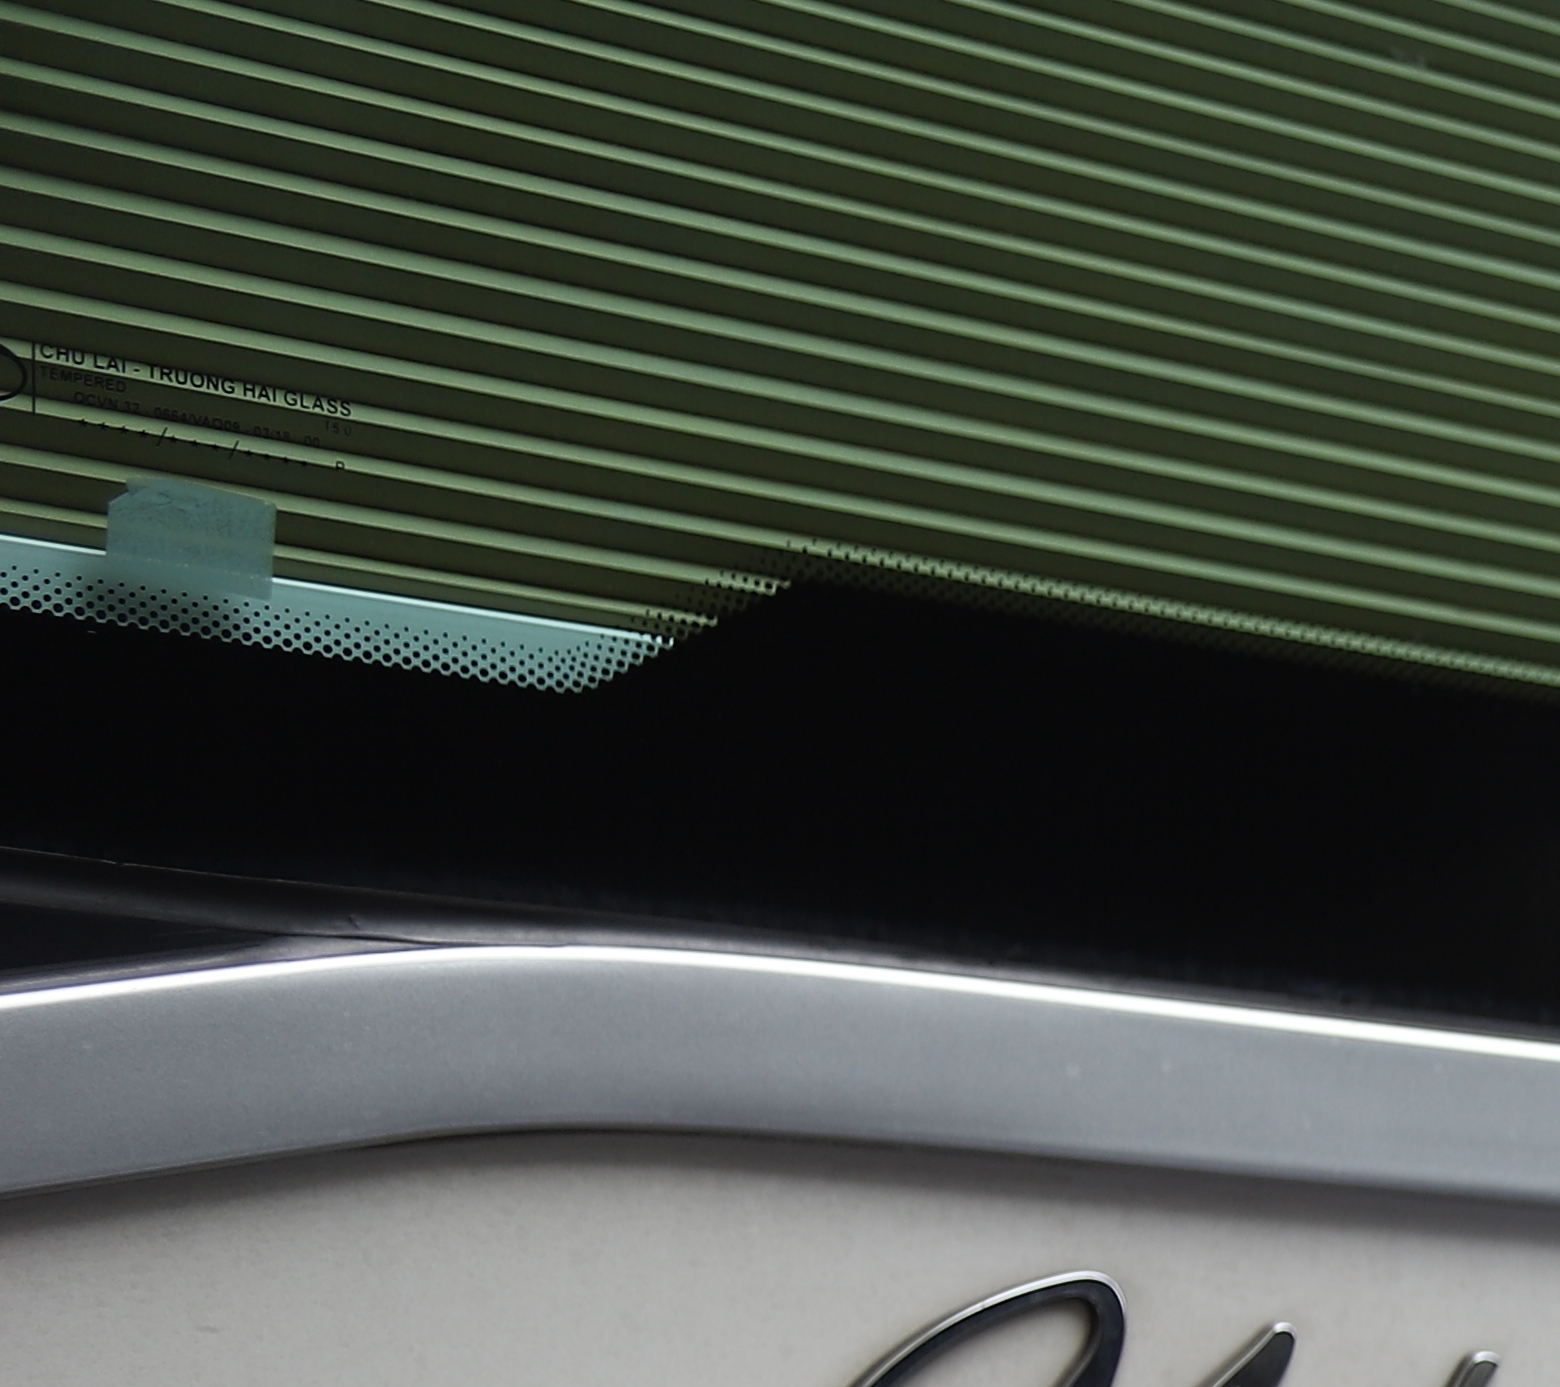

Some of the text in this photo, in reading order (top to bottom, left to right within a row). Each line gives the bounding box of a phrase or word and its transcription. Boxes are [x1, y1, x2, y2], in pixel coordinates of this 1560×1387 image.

[40, 365, 127, 393] TEMPERED
[40, 343, 85, 365] CHU
[94, 354, 126, 374] LAI
[150, 364, 236, 395] TRUONG
[243, 382, 277, 404] HAI
[284, 390, 352, 418] GLASS
